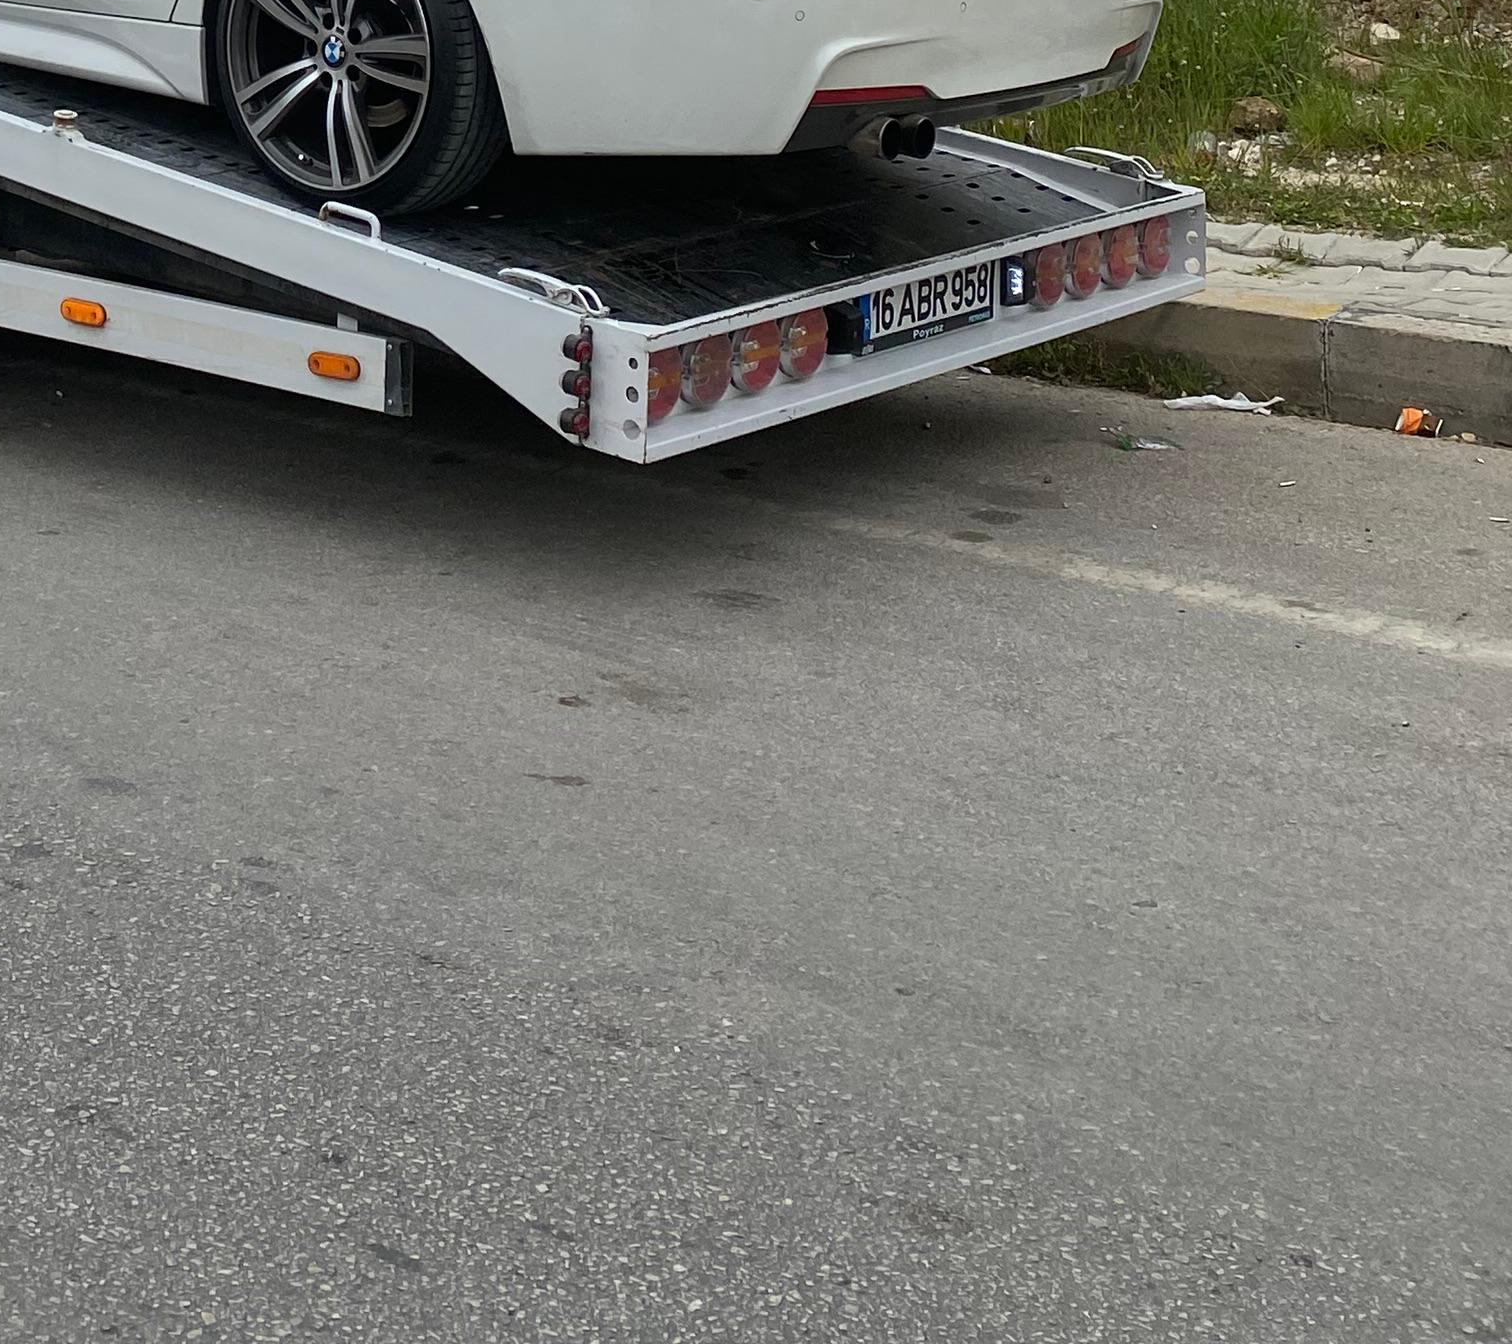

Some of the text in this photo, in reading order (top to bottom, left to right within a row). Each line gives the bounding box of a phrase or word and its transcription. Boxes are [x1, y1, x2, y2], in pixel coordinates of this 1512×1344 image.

[872, 262, 989, 334] 16 ABR 958
[913, 323, 945, 340] Poyraz
